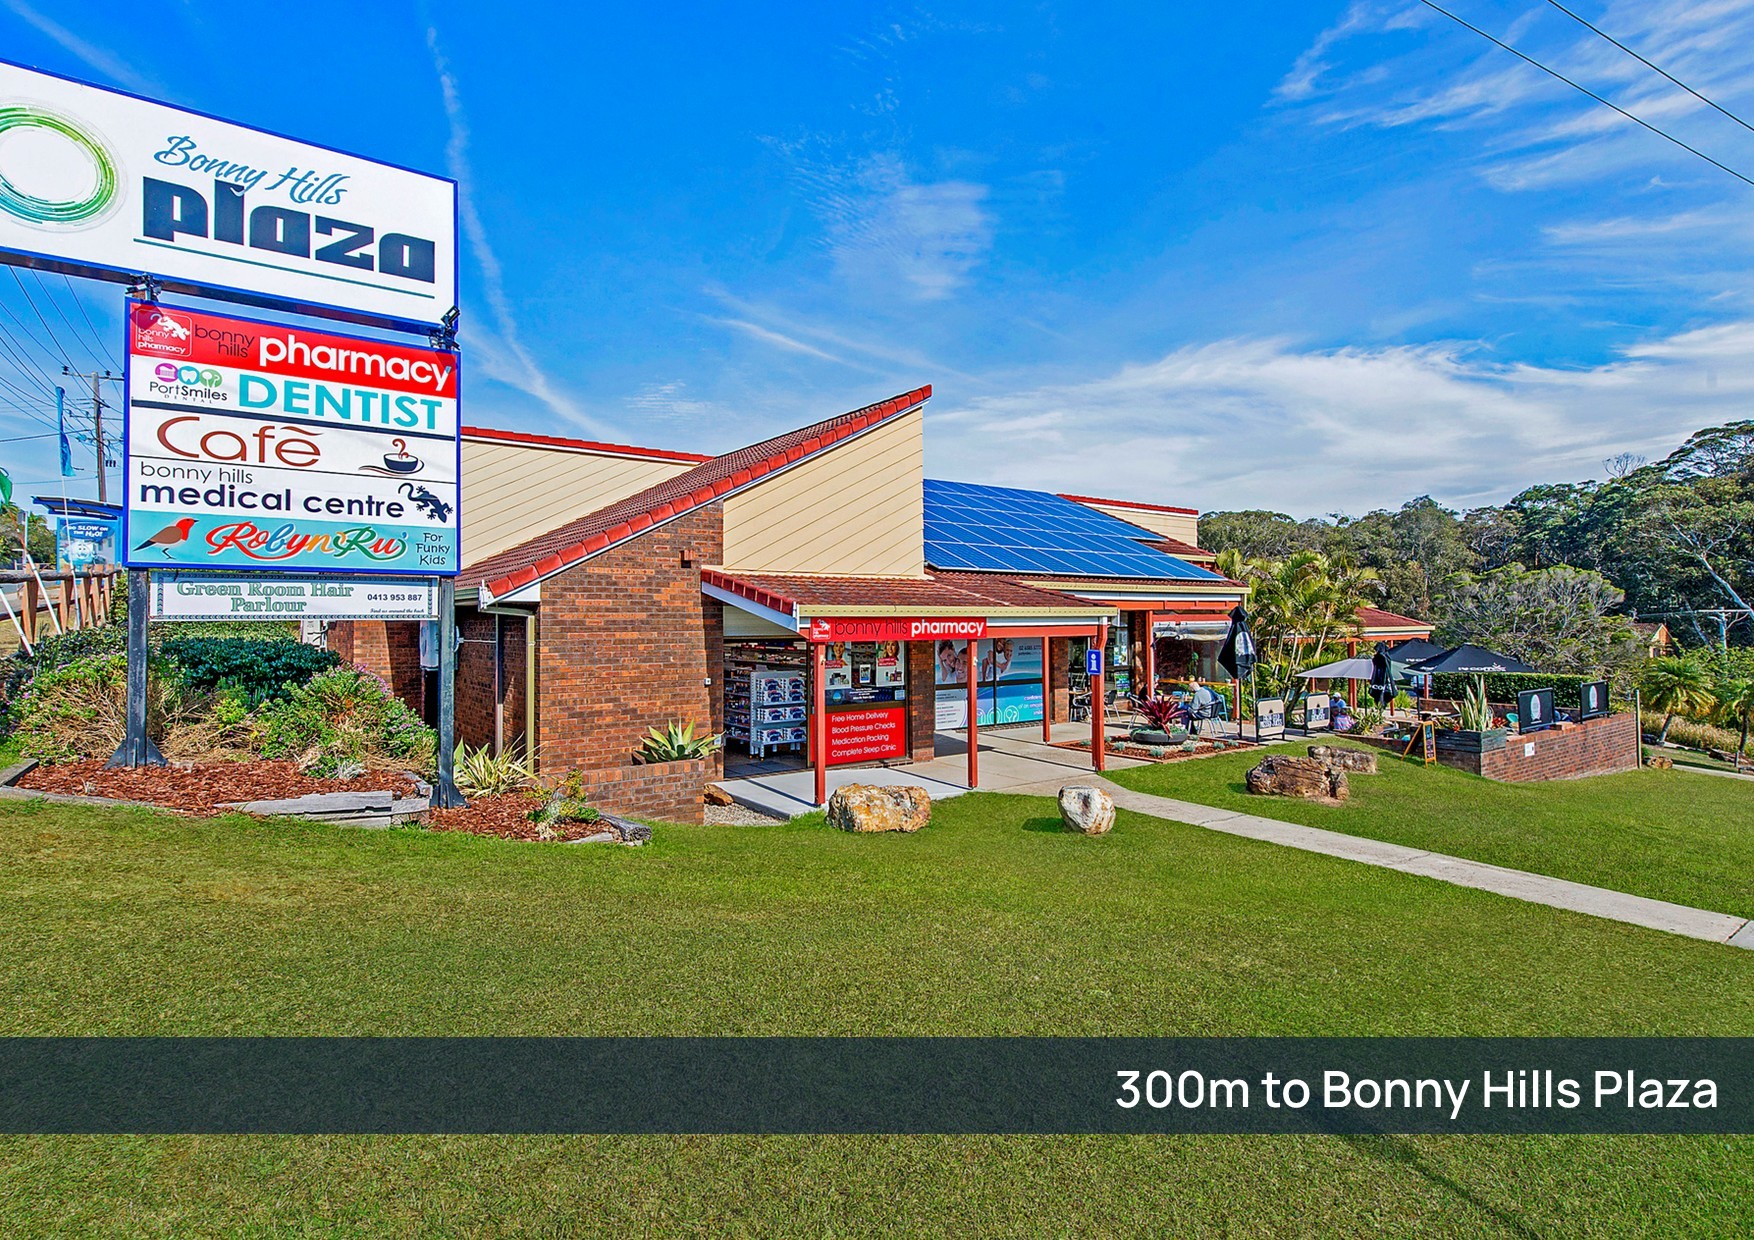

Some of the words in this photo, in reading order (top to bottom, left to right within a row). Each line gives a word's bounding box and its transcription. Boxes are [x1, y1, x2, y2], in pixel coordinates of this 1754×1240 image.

[153, 135, 268, 196] Bonny
[266, 166, 351, 205] Hills
[143, 176, 436, 284] plaza
[137, 327, 170, 339] bonny
[137, 334, 154, 343] hills
[194, 324, 255, 348] bonny
[137, 342, 186, 355] pharmacy
[217, 341, 249, 358] hills
[259, 334, 449, 391] pharmacy
[164, 394, 213, 404] DENTAL
[239, 373, 443, 430] DENTIST
[140, 461, 212, 484] bonny
[219, 467, 254, 485] hills
[140, 484, 292, 511] medical
[303, 494, 405, 518] centre
[423, 532, 444, 542] For
[416, 543, 450, 554] Funky
[419, 554, 447, 566] Kids
[176, 580, 243, 596] Green
[248, 582, 306, 597] Room
[310, 583, 355, 597] Hair
[367, 593, 389, 601] 0413
[230, 597, 307, 612] Parlour
[834, 619, 882, 636] bonny
[885, 618, 908, 635] hills
[911, 619, 985, 638] pharmacy
[831, 715, 846, 723] Free
[846, 713, 865, 721] Home
[866, 711, 889, 720] Delivery
[831, 726, 849, 734] Blood
[850, 724, 874, 732] Pressure
[874, 721, 896, 730] Checks
[831, 737, 866, 746] Medication
[866, 734, 889, 742] Packing
[831, 747, 863, 757] Complete
[863, 746, 880, 754] Sleep
[880, 743, 897, 752] Clinic
